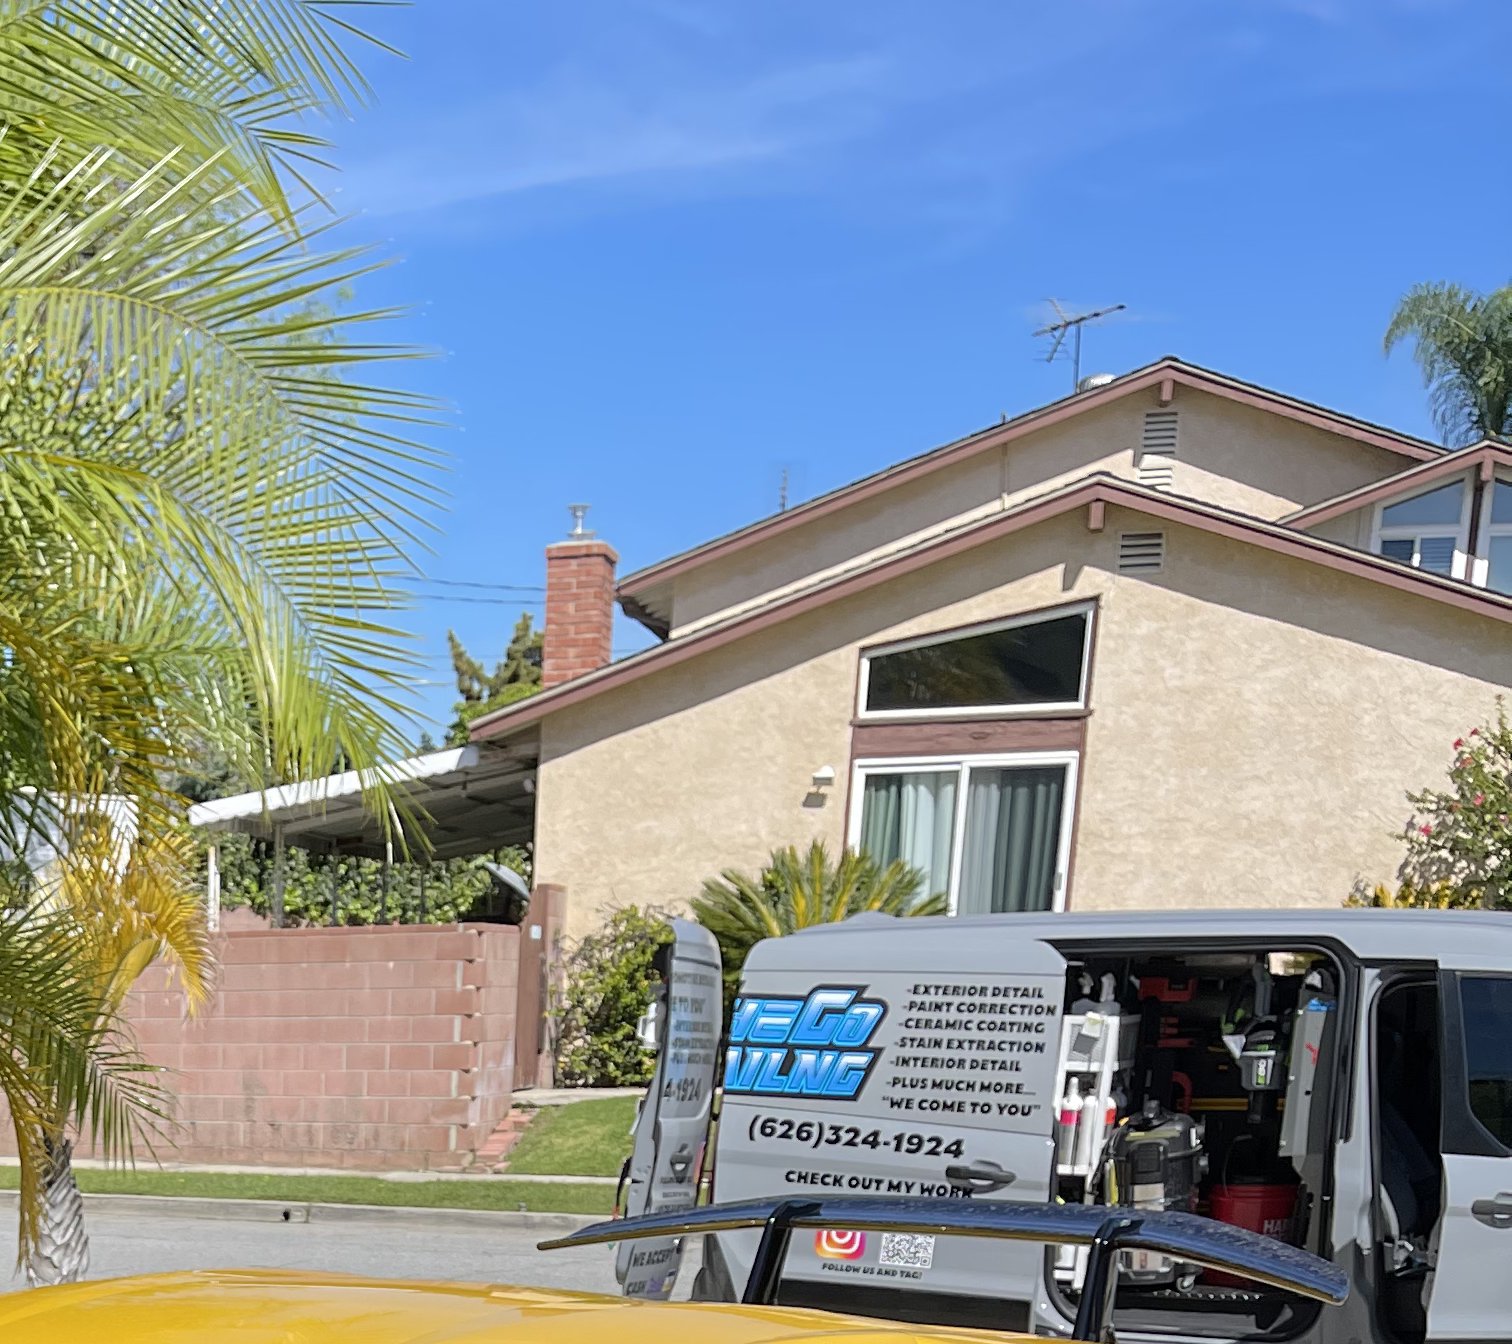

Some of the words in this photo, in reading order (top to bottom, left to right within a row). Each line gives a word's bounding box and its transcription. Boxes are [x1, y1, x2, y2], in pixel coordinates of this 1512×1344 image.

[991, 985, 1045, 999] DETAIL
[956, 1001, 1058, 1017] CORRECTION
[977, 1019, 1046, 1034] COATING
[946, 1038, 1047, 1054] EXTRACTION
[969, 1058, 1022, 1072] DETAIL
[931, 1078, 976, 1093] MUCH
[918, 1098, 966, 1113] COME
[970, 1101, 992, 1115] TO
[748, 1114, 966, 1159] (626)324-1924
[785, 1169, 844, 1188] CHECK
[848, 1176, 884, 1192] OUT
[887, 1179, 917, 1195] MY
[920, 1183, 975, 1199] WORK
[821, 1262, 861, 1274] FOLLOW
[862, 1266, 875, 1275] US
[877, 1268, 898, 1277] AND
